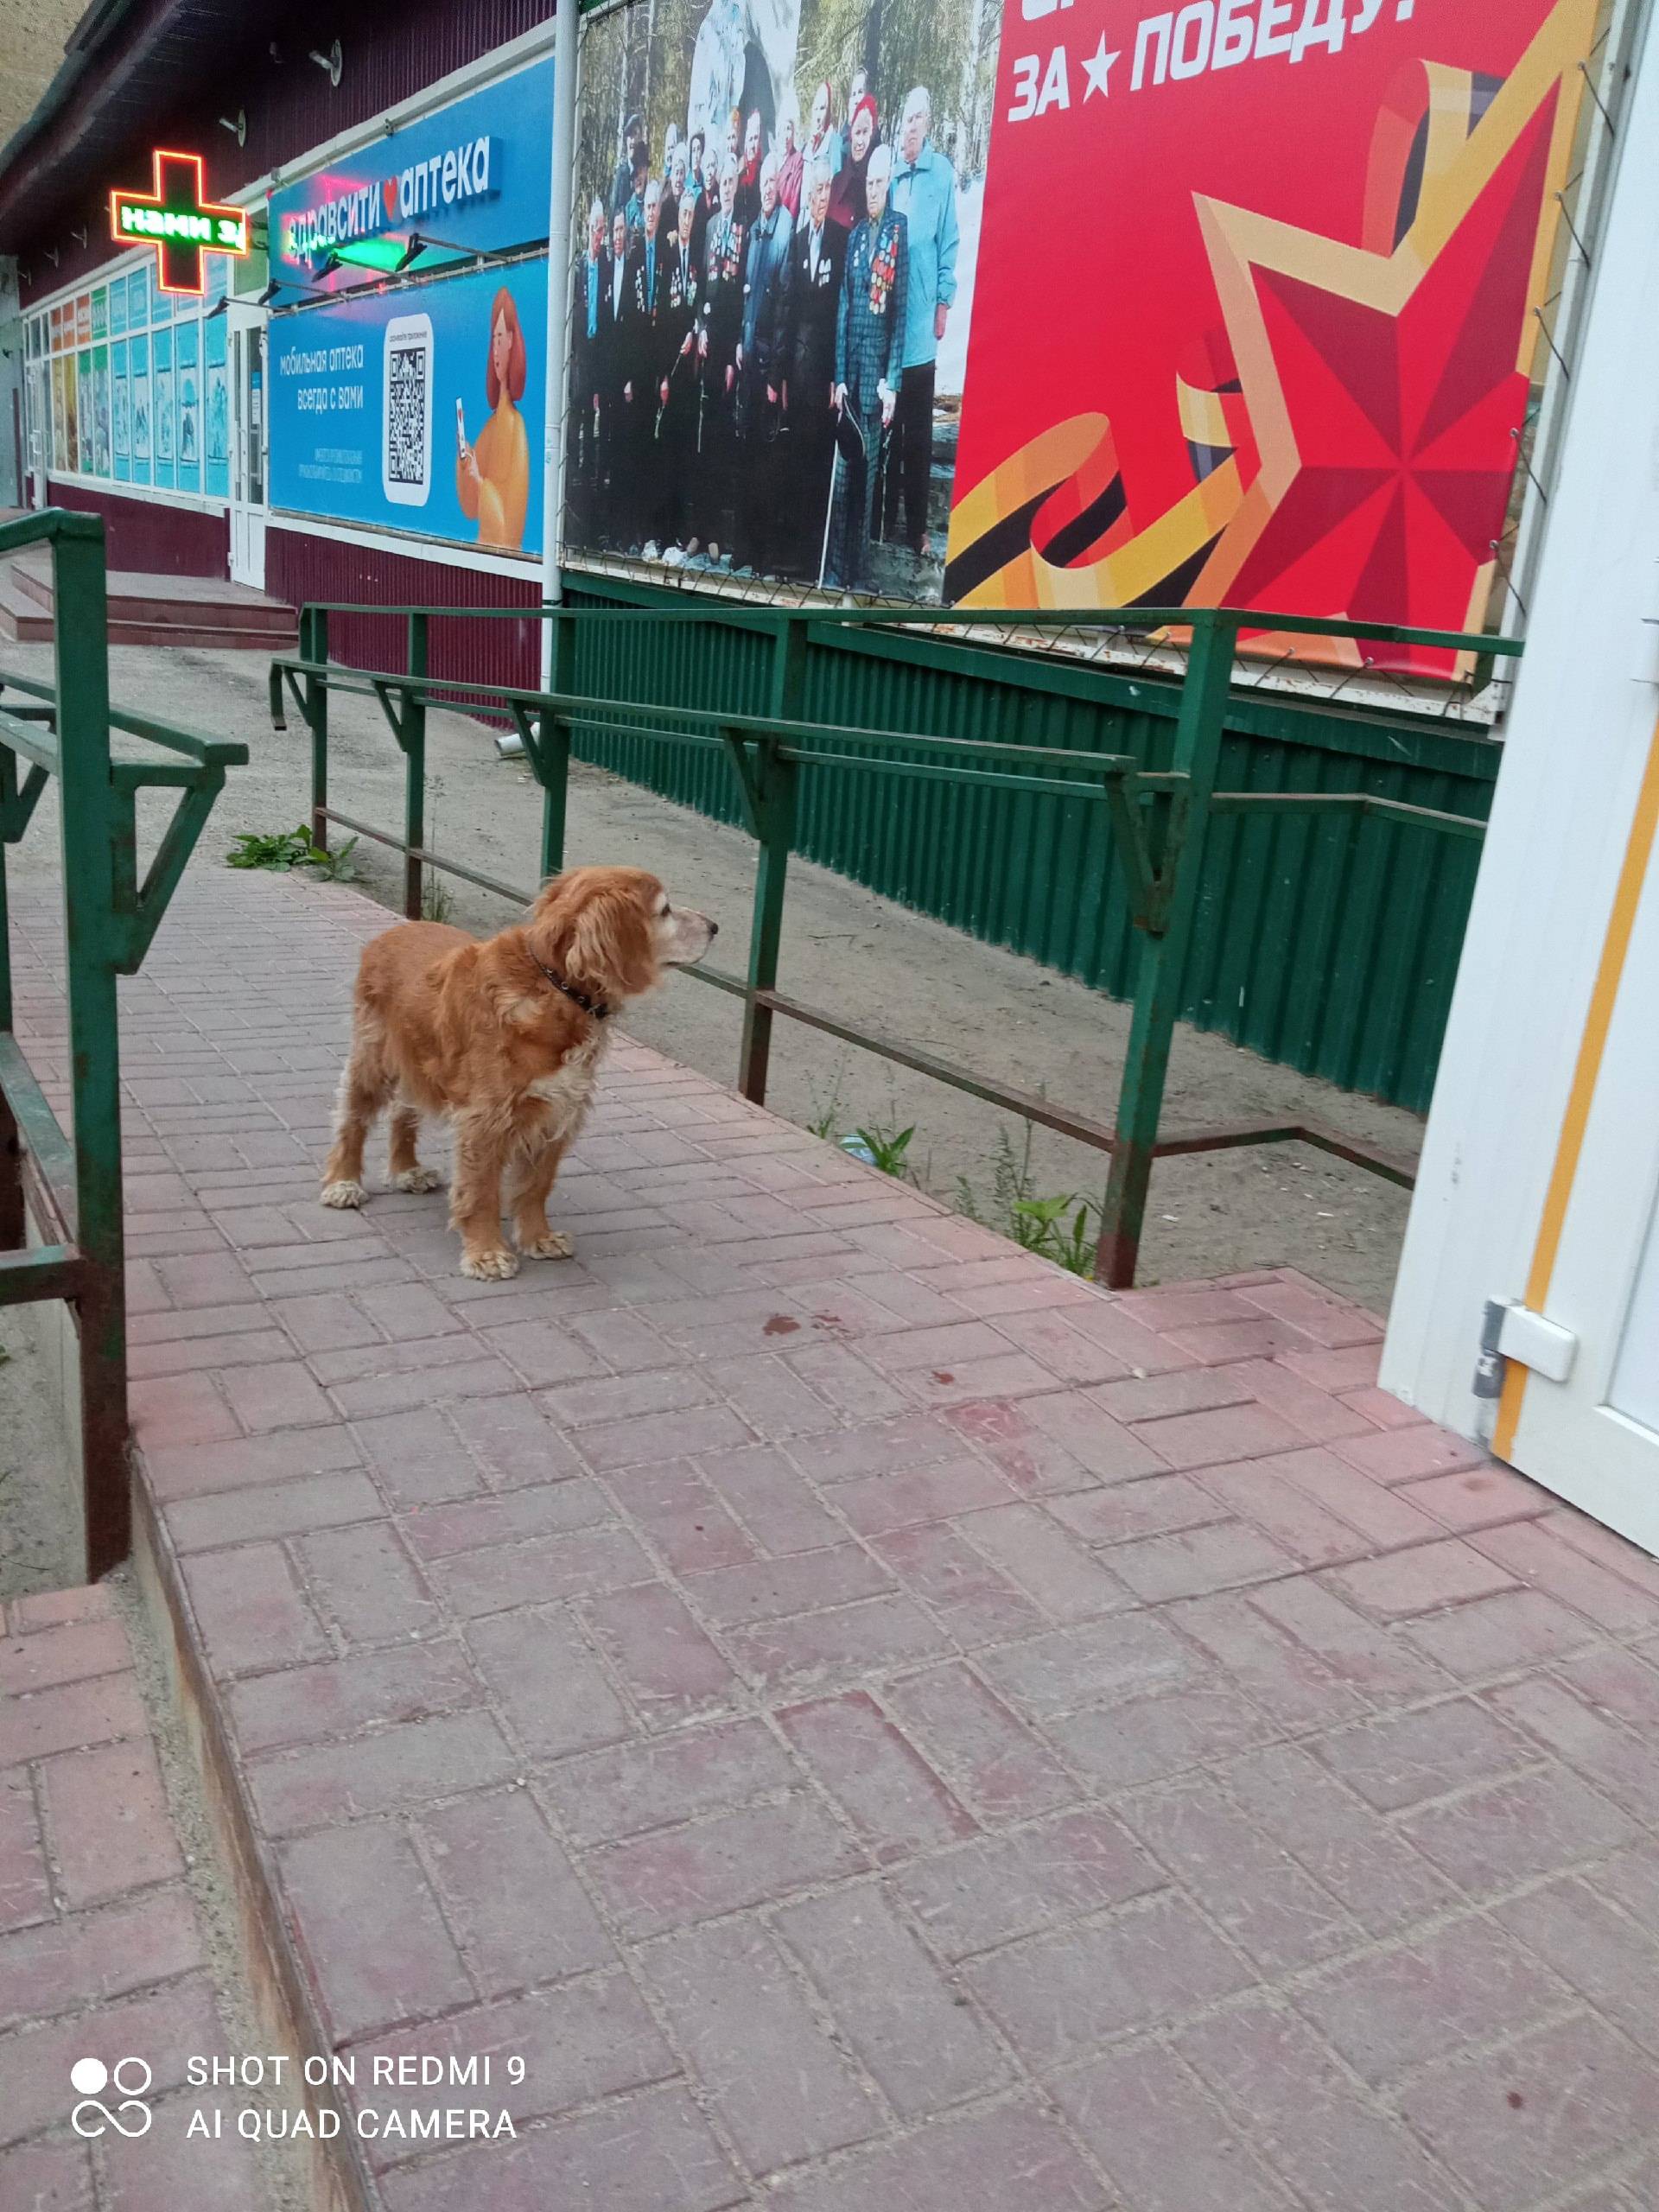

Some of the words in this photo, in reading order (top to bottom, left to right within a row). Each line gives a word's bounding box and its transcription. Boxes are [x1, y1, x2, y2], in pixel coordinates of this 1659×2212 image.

[1007, 45, 1071, 123] ЗА
[1129, 0, 1414, 92] ПОБЕД
[289, 181, 380, 270] здравсити
[399, 136, 490, 219] аптека
[121, 206, 212, 242] нами
[279, 346, 327, 376] мобильная
[329, 344, 364, 372] аптека
[297, 387, 327, 415] всегда
[329, 387, 336, 410] с
[339, 385, 364, 410] вами
